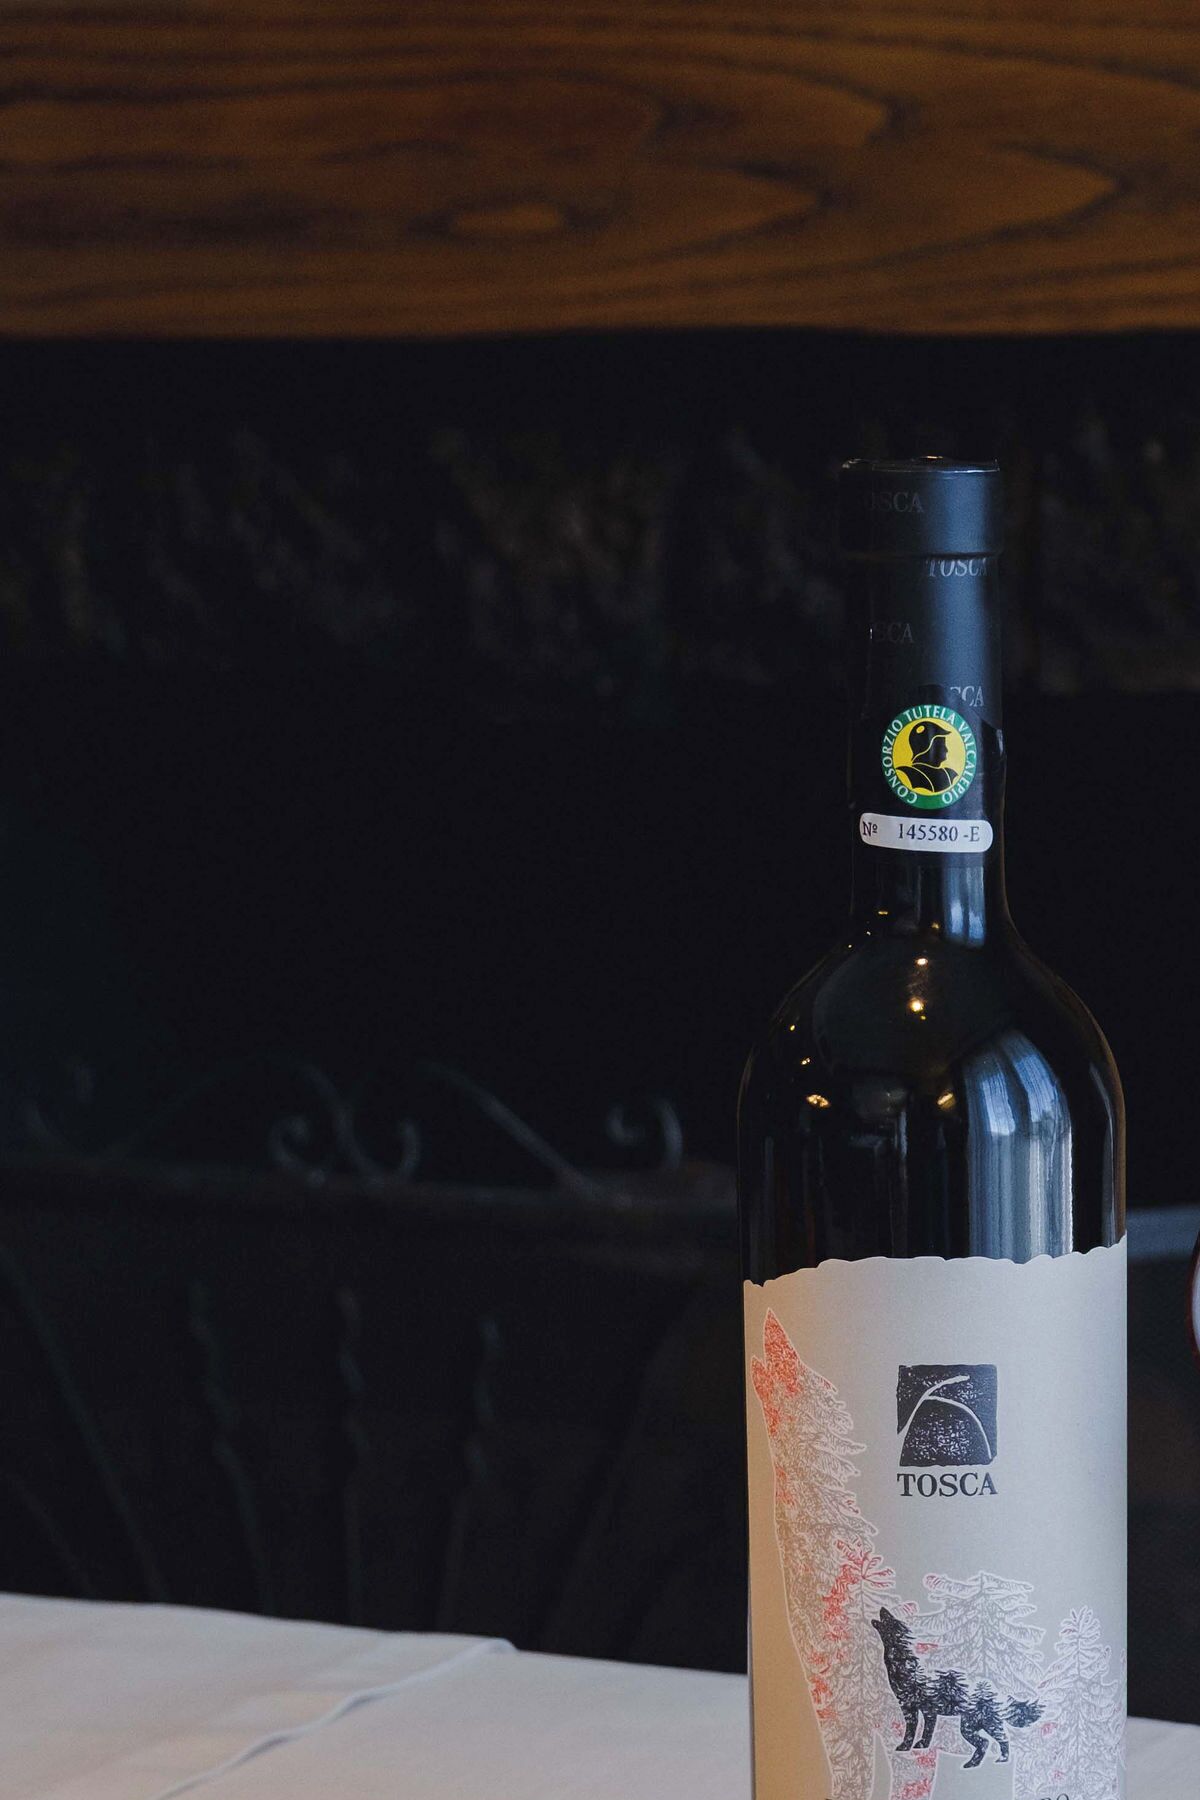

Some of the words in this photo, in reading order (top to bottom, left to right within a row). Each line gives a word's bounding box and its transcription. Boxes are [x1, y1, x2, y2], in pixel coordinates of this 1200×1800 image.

[882, 719, 918, 804] CONSORZIO
[903, 705, 956, 725] TUTELA
[941, 723, 977, 805] VALCALEPIO
[898, 823, 958, 842] 145580
[896, 1472, 999, 1498] TOSCA
